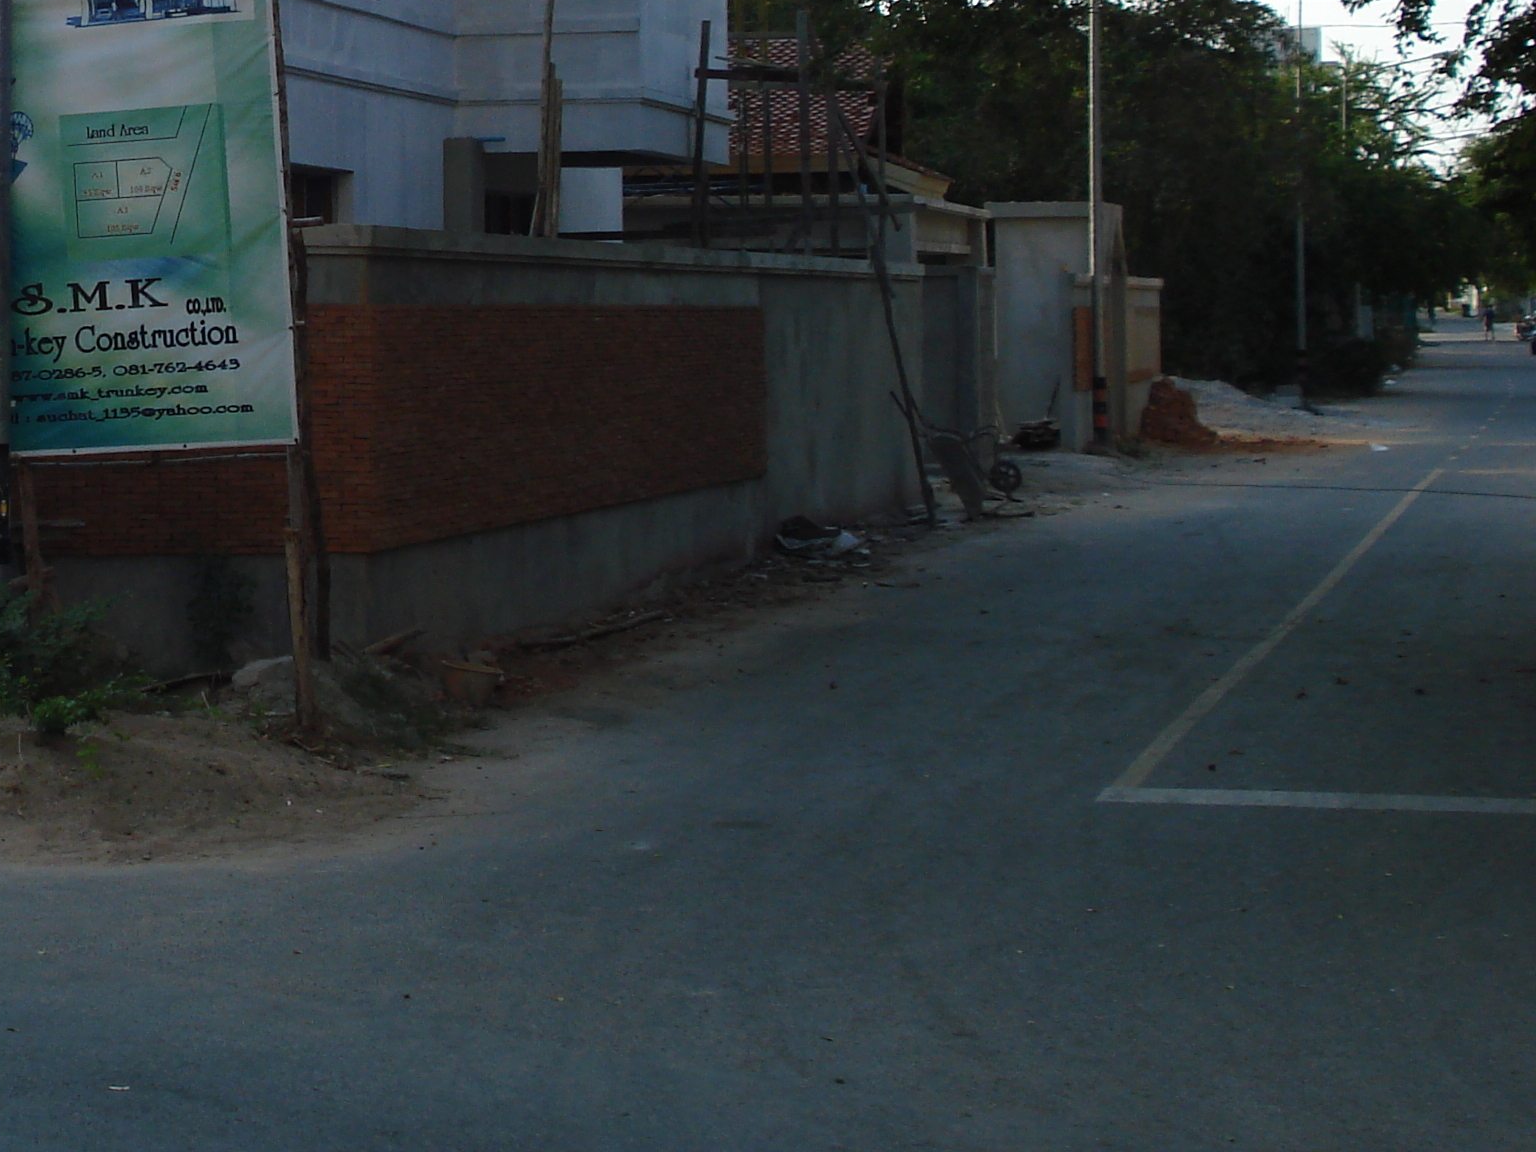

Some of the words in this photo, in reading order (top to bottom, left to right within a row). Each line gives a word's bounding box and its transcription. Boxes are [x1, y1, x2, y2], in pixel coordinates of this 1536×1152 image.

[86, 124, 115, 139] Land
[120, 124, 149, 136] Area
[11, 278, 168, 315] S.M.K
[75, 320, 239, 353] Construction
